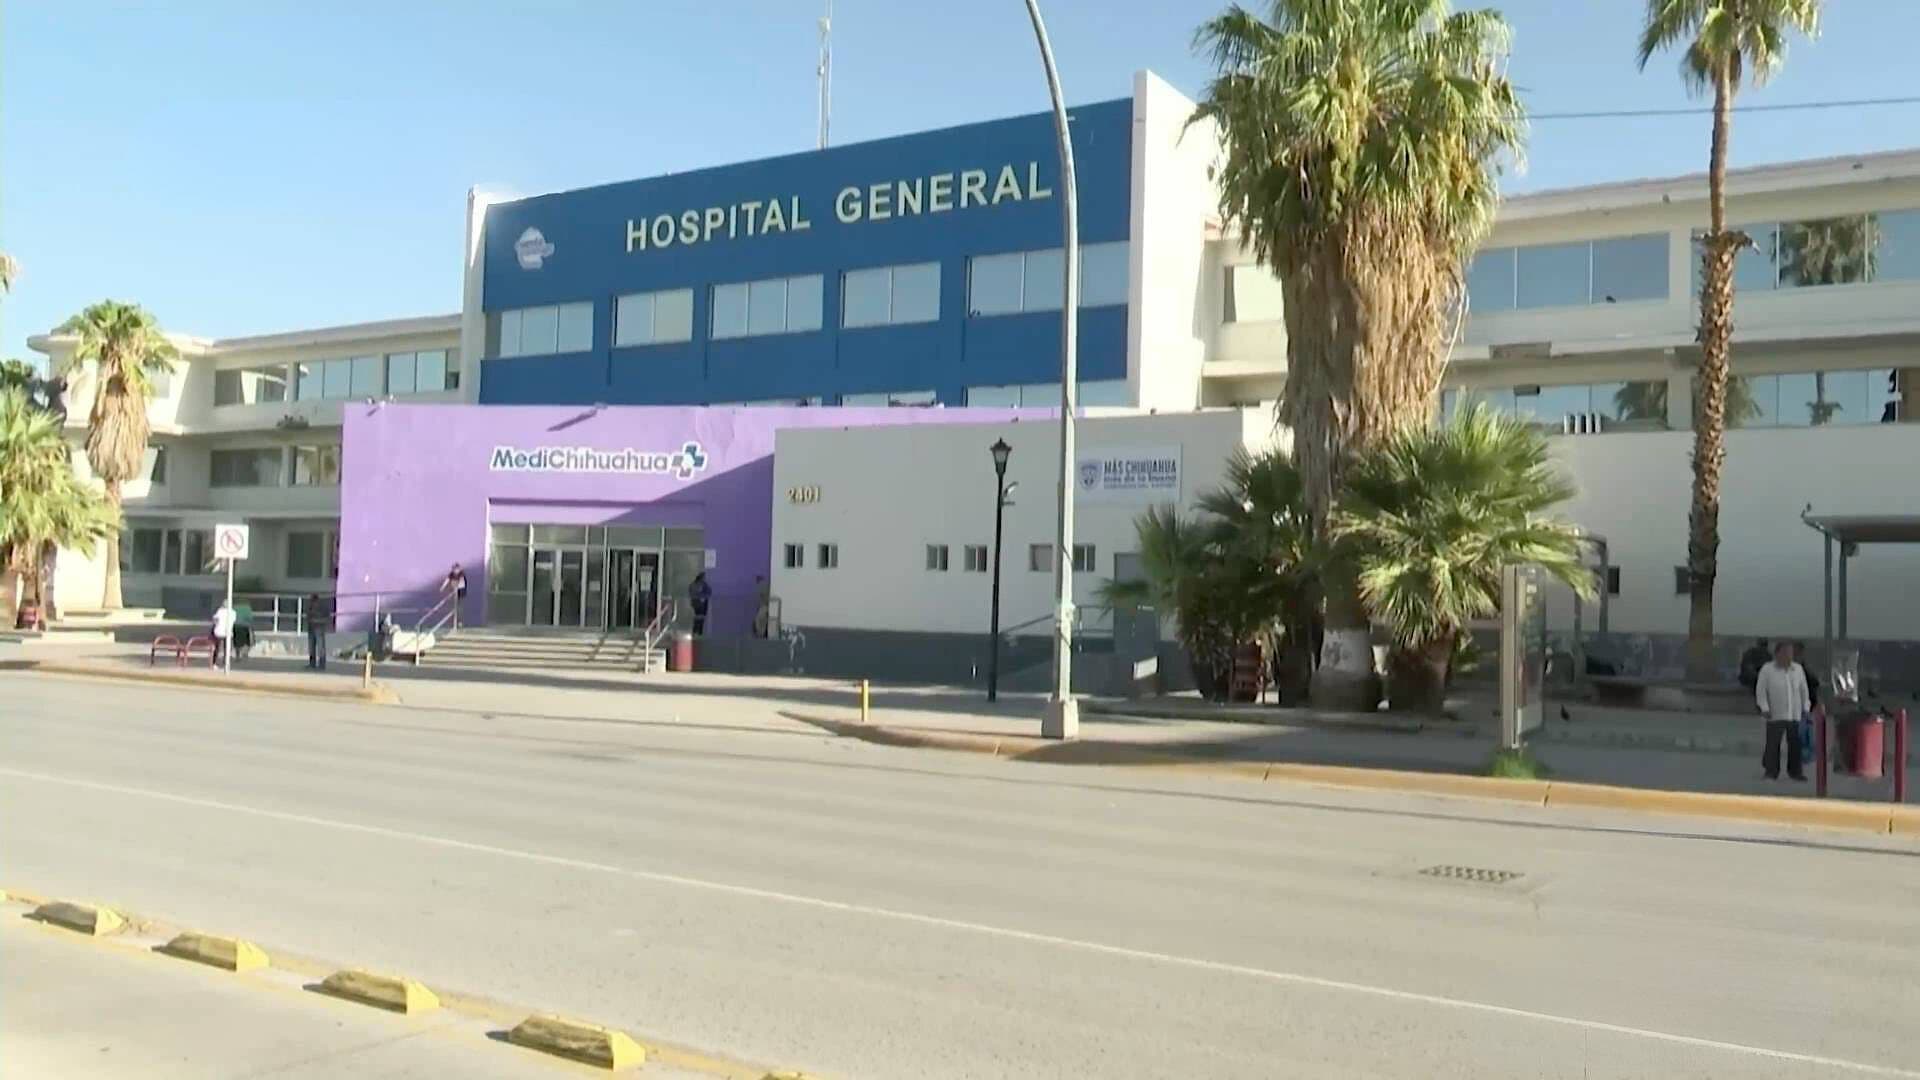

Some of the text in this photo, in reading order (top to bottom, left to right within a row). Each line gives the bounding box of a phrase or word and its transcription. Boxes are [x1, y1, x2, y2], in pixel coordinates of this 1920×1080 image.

[625, 161, 1053, 253] HOSPITAL GENERAL
[491, 446, 668, 472] MediChihuahua
[1125, 459, 1177, 473] CHIHUAHUA
[787, 486, 820, 504] 2401
